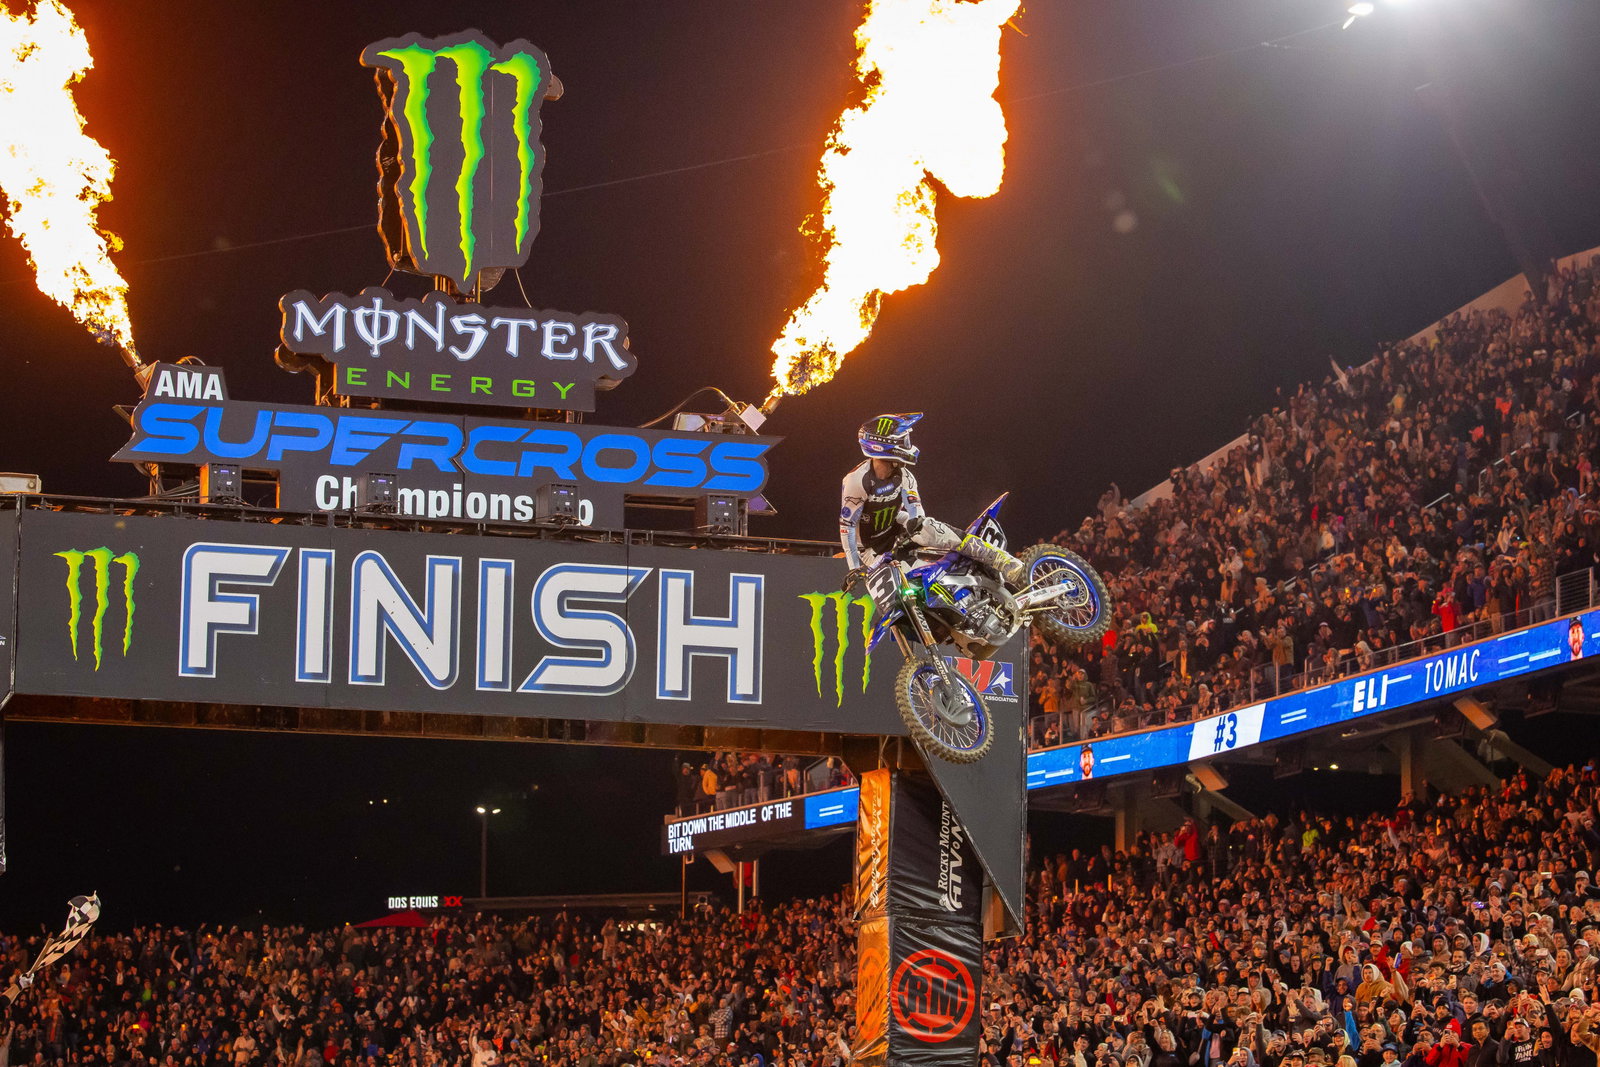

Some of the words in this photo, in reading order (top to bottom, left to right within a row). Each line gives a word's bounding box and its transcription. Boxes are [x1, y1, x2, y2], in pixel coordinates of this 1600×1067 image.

[292, 296, 629, 371] MONSTER
[154, 369, 224, 401] AMA
[346, 366, 576, 400] ENERGY
[131, 402, 772, 493] SUPERCROSS
[869, 435, 898, 444] OAKLEY
[315, 474, 594, 527] Chmpionsp
[868, 566, 897, 604] 3
[178, 542, 765, 705] FINISH
[984, 695, 1018, 703] ASSOCIATION
[1352, 674, 1388, 713] ELI
[1424, 649, 1480, 693] TOMAC
[1214, 713, 1238, 752] #3
[668, 823, 681, 839] BIT
[682, 818, 707, 836] DOWN
[708, 814, 725, 832] THE
[725, 808, 757, 829] MIDDLE
[761, 806, 774, 822] OF
[774, 802, 792, 819] THE
[939, 801, 951, 849] MOUNT
[668, 836, 694, 854] TURN.
[938, 850, 949, 891] ROCKY
[388, 896, 408, 909] DOS
[409, 895, 439, 909] EQUIS
[443, 895, 463, 907] XX
